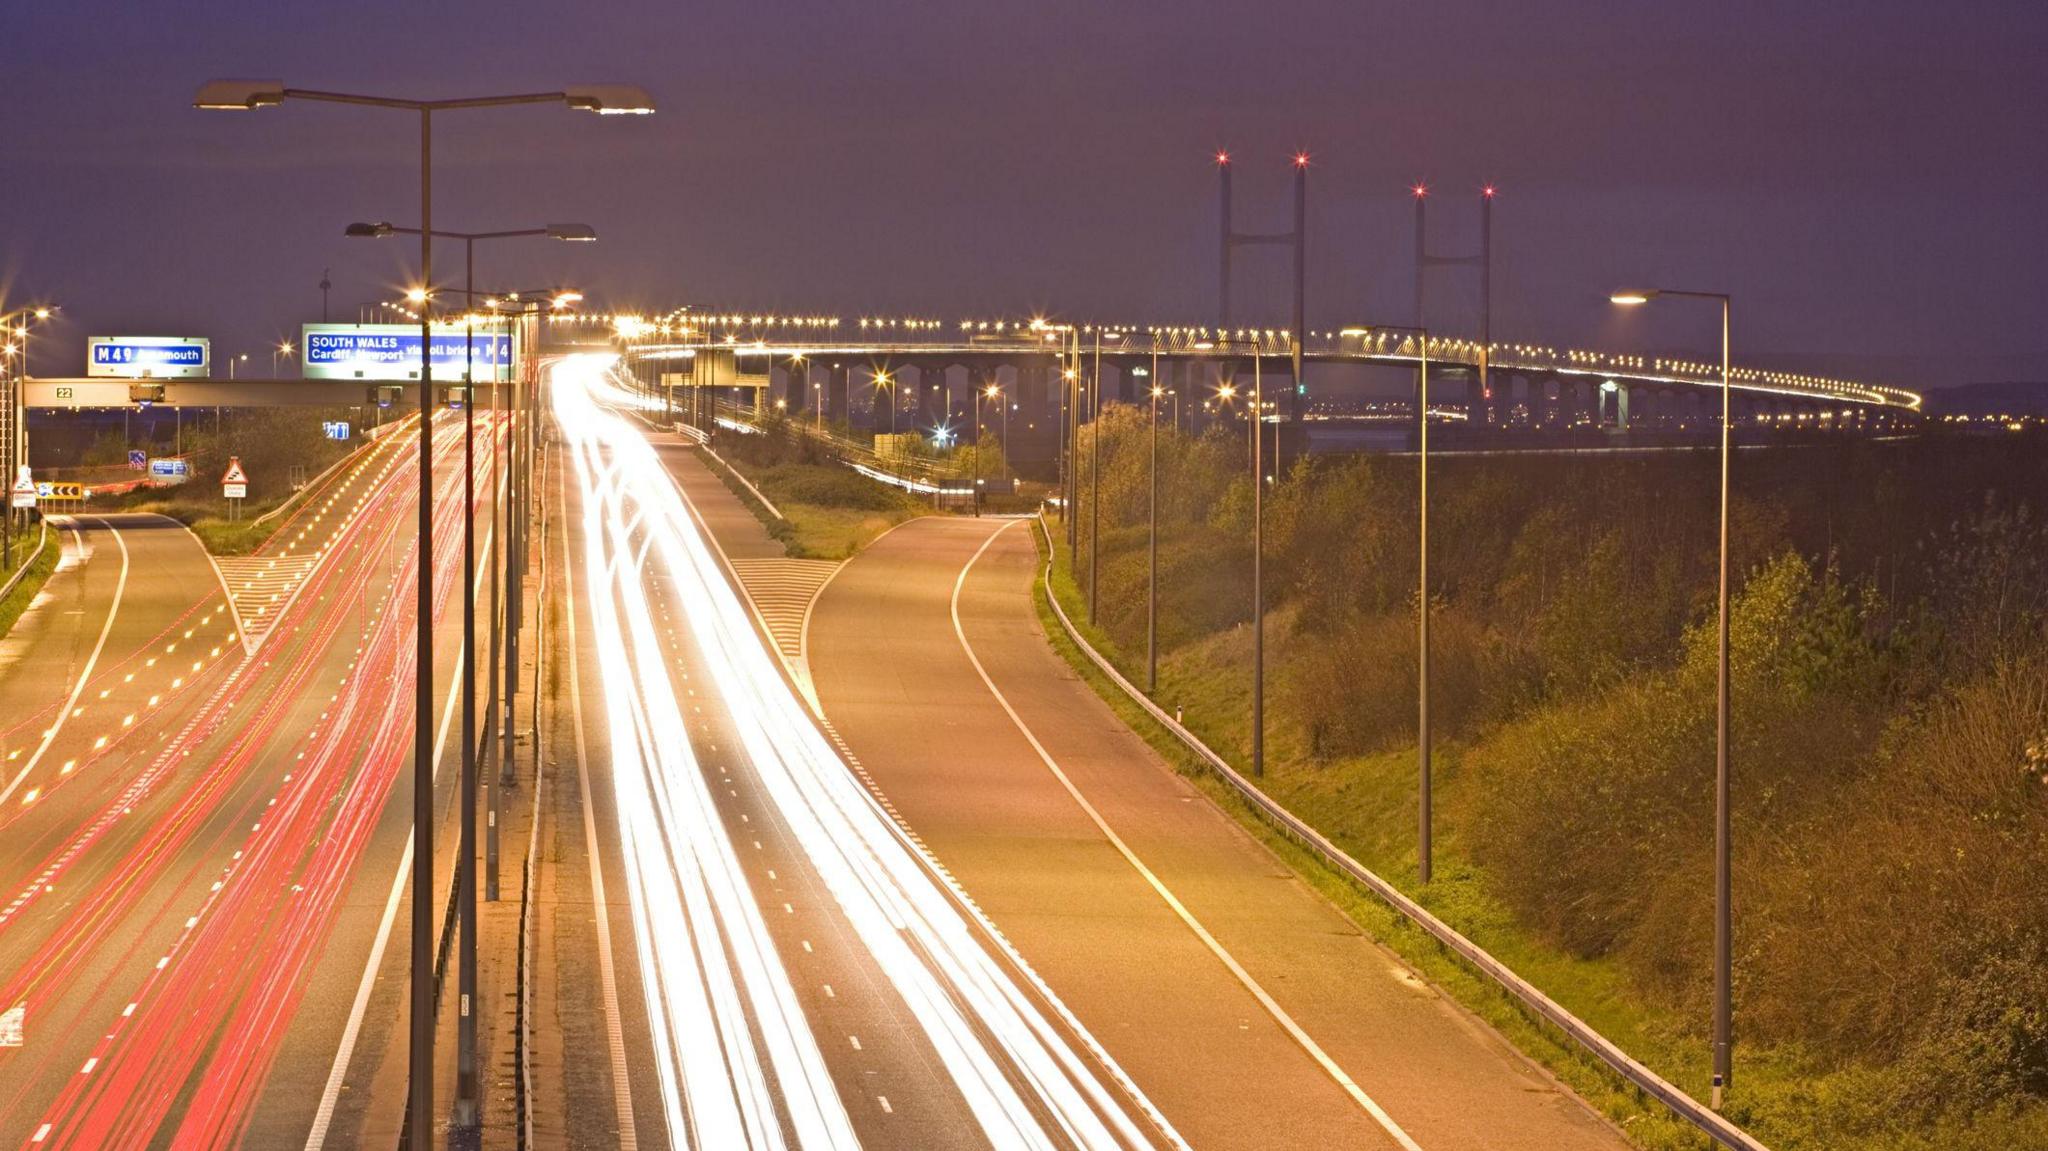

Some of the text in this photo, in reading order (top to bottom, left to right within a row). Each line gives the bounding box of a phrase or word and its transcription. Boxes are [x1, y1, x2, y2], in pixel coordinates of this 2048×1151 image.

[312, 337, 398, 348] SOUTH WALES
[430, 344, 444, 355] oll
[446, 344, 481, 356] bride
[58, 388, 71, 397] 22
